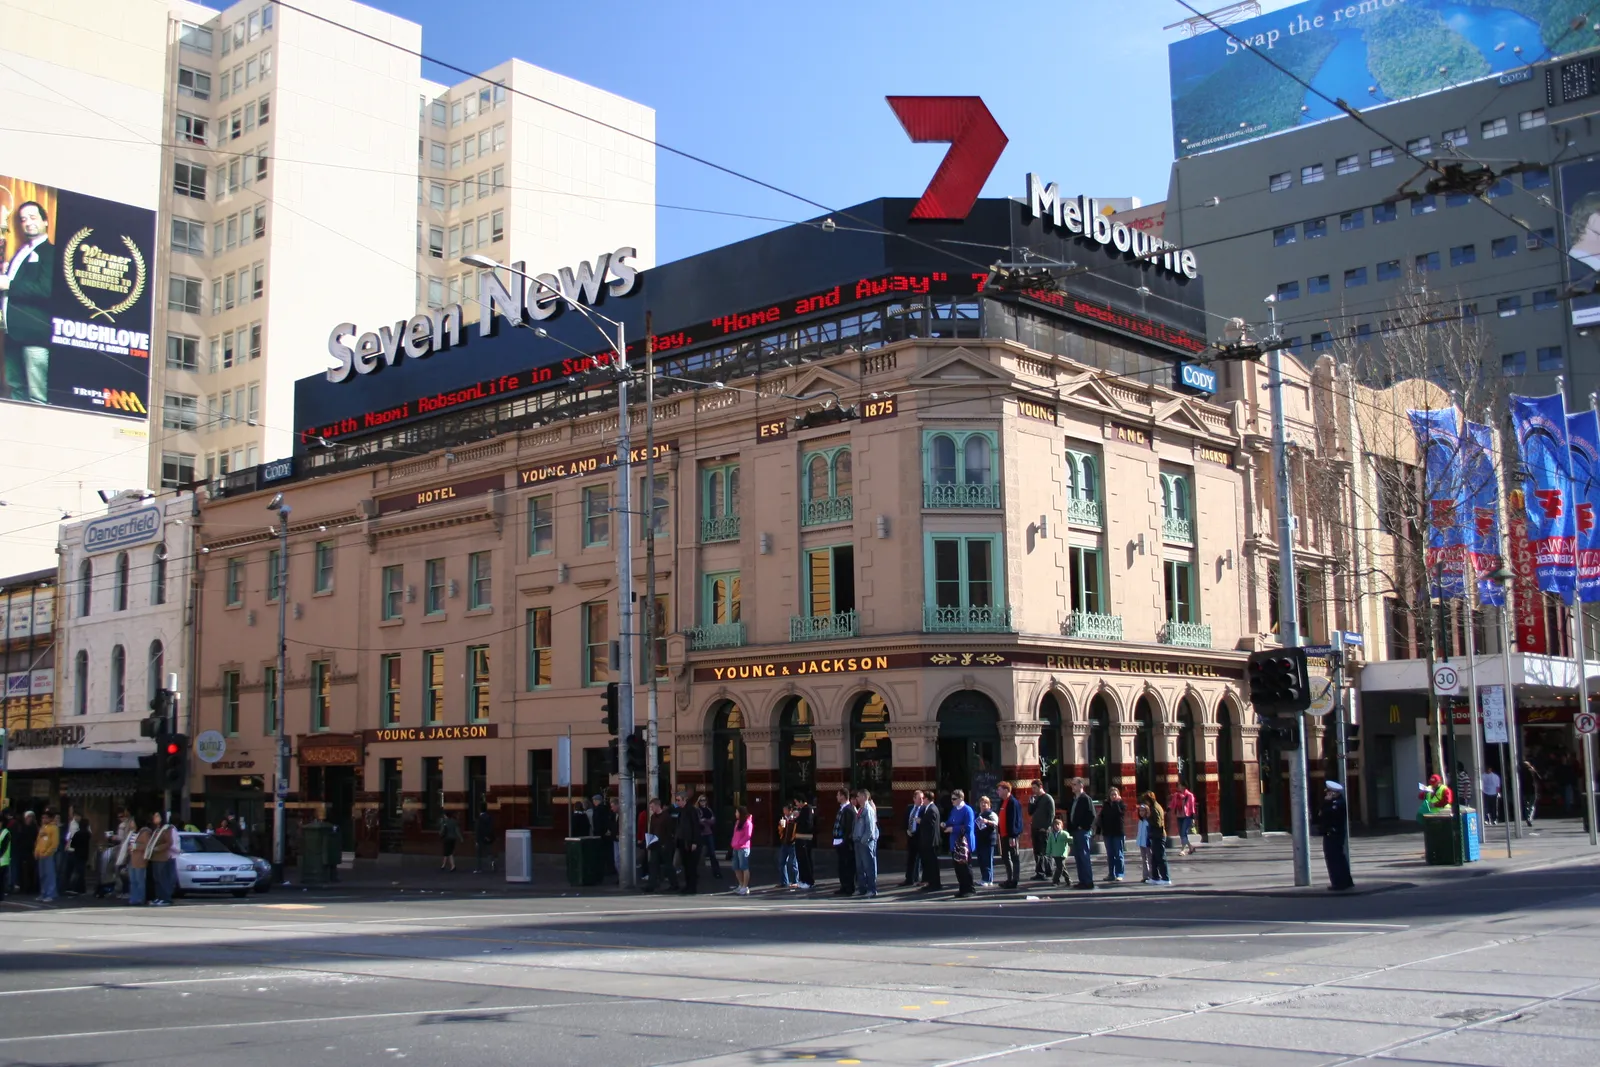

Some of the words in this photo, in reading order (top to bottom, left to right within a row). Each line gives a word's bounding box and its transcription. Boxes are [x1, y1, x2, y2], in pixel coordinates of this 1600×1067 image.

[1226, 28, 1280, 55] Swap
[1288, 14, 1324, 36] the
[1332, 0, 1404, 22] remo
[1026, 171, 1197, 279] Melbourne
[80, 243, 132, 264] Winner
[83, 256, 107, 268] SHOW
[108, 261, 129, 272] WITH
[87, 264, 102, 274] THE
[102, 267, 125, 278] MOST
[75, 269, 120, 285] REFERENCES
[121, 278, 132, 287] TO
[80, 278, 129, 294] UNDERPANTS
[326, 302, 463, 384] Seven
[479, 246, 638, 338] News
[52, 317, 149, 351] TOUGHLOVE
[322, 420, 358, 439] with
[364, 402, 409, 428] Naomi
[531, 366, 552, 384] in
[711, 304, 781, 334] "Home
[795, 285, 841, 314] and
[855, 271, 948, 300] Away"
[1183, 365, 1214, 393] CODY
[73, 386, 111, 400] TRIPLE
[865, 400, 893, 417] 1875
[1018, 401, 1055, 422] YOUNG
[1118, 426, 1145, 445] AND
[264, 459, 291, 481] CODY
[522, 464, 566, 484] YOUNG
[570, 458, 597, 474] AND
[606, 443, 670, 466] JAKSON
[418, 486, 457, 504] HOTEL
[88, 510, 155, 542] Dangerfield
[714, 664, 776, 680] YOUNG
[782, 665, 790, 676] &
[798, 655, 889, 675] JACKSON
[1046, 655, 1110, 672] PRINCE'S
[1120, 659, 1169, 674] BRIDGE
[1437, 672, 1455, 686] 30
[376, 729, 416, 741] YOUNG
[419, 731, 425, 739] &
[428, 725, 487, 740] JACKSON
[199, 740, 223, 751] BOTTLE
[212, 761, 236, 770] BOTTLE
[237, 760, 255, 769] SHOP
